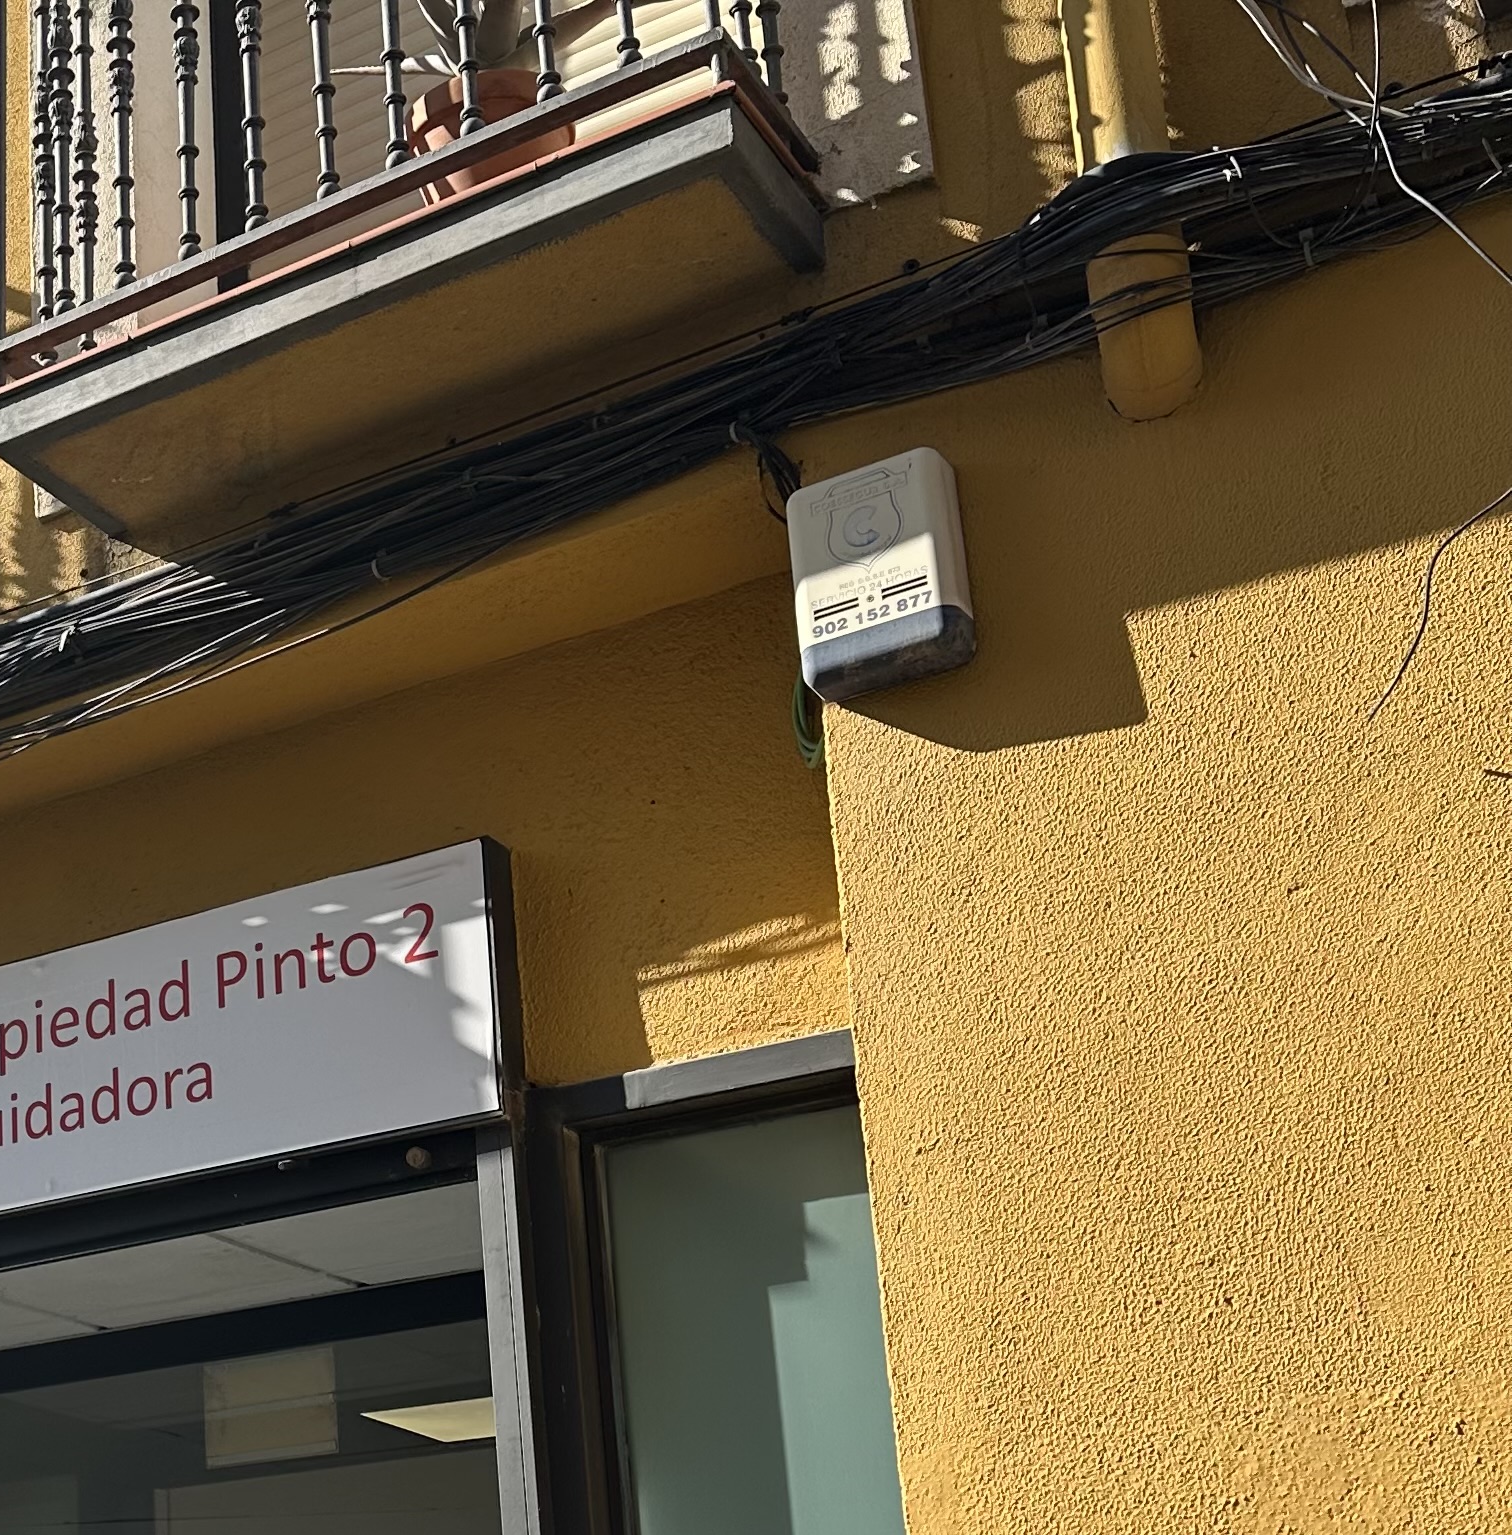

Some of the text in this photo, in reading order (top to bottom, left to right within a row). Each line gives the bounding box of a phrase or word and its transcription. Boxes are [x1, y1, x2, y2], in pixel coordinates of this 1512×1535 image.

[811, 565, 929, 609] SERVICIO 24 HORAS
[812, 590, 933, 639] 902 152 877
[216, 931, 377, 1009] Pinto
[402, 902, 439, 964] 2
